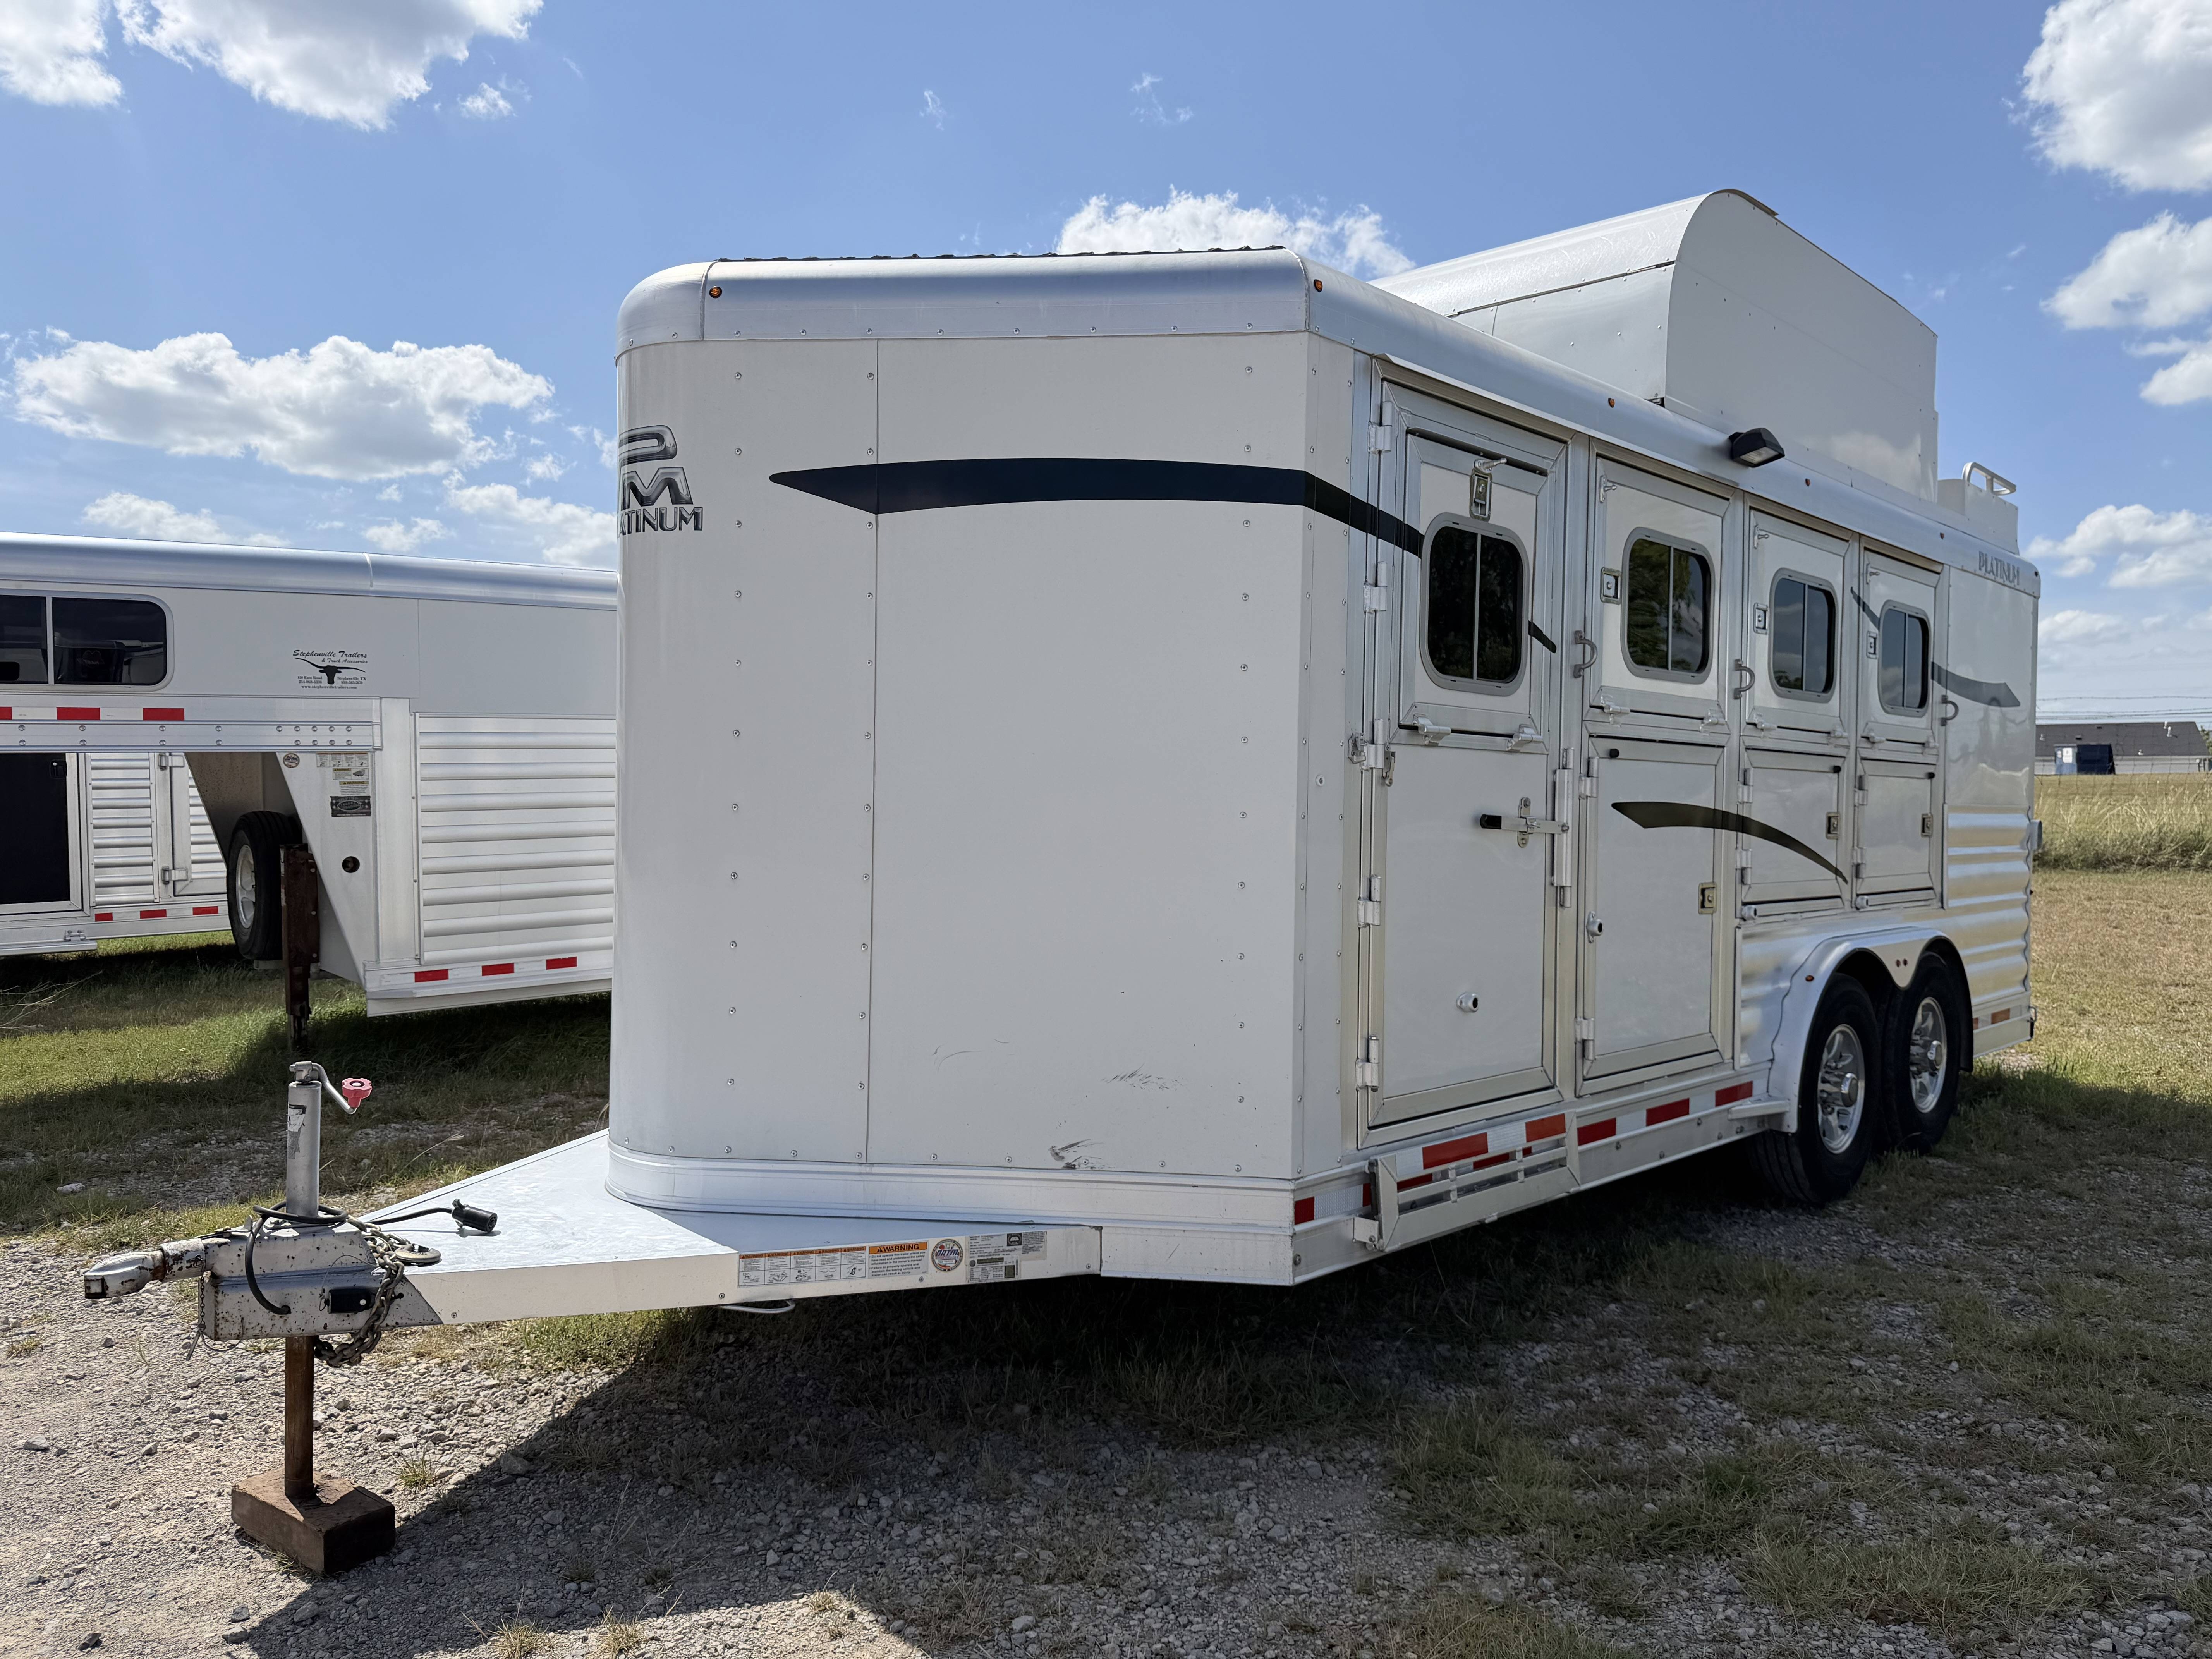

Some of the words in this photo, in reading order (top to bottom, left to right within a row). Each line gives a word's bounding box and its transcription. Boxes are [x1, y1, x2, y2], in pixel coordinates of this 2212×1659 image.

[618, 507, 703, 538] ATINUM
[1978, 551, 2020, 586] PLATINUM
[293, 649, 336, 658] Stephenville
